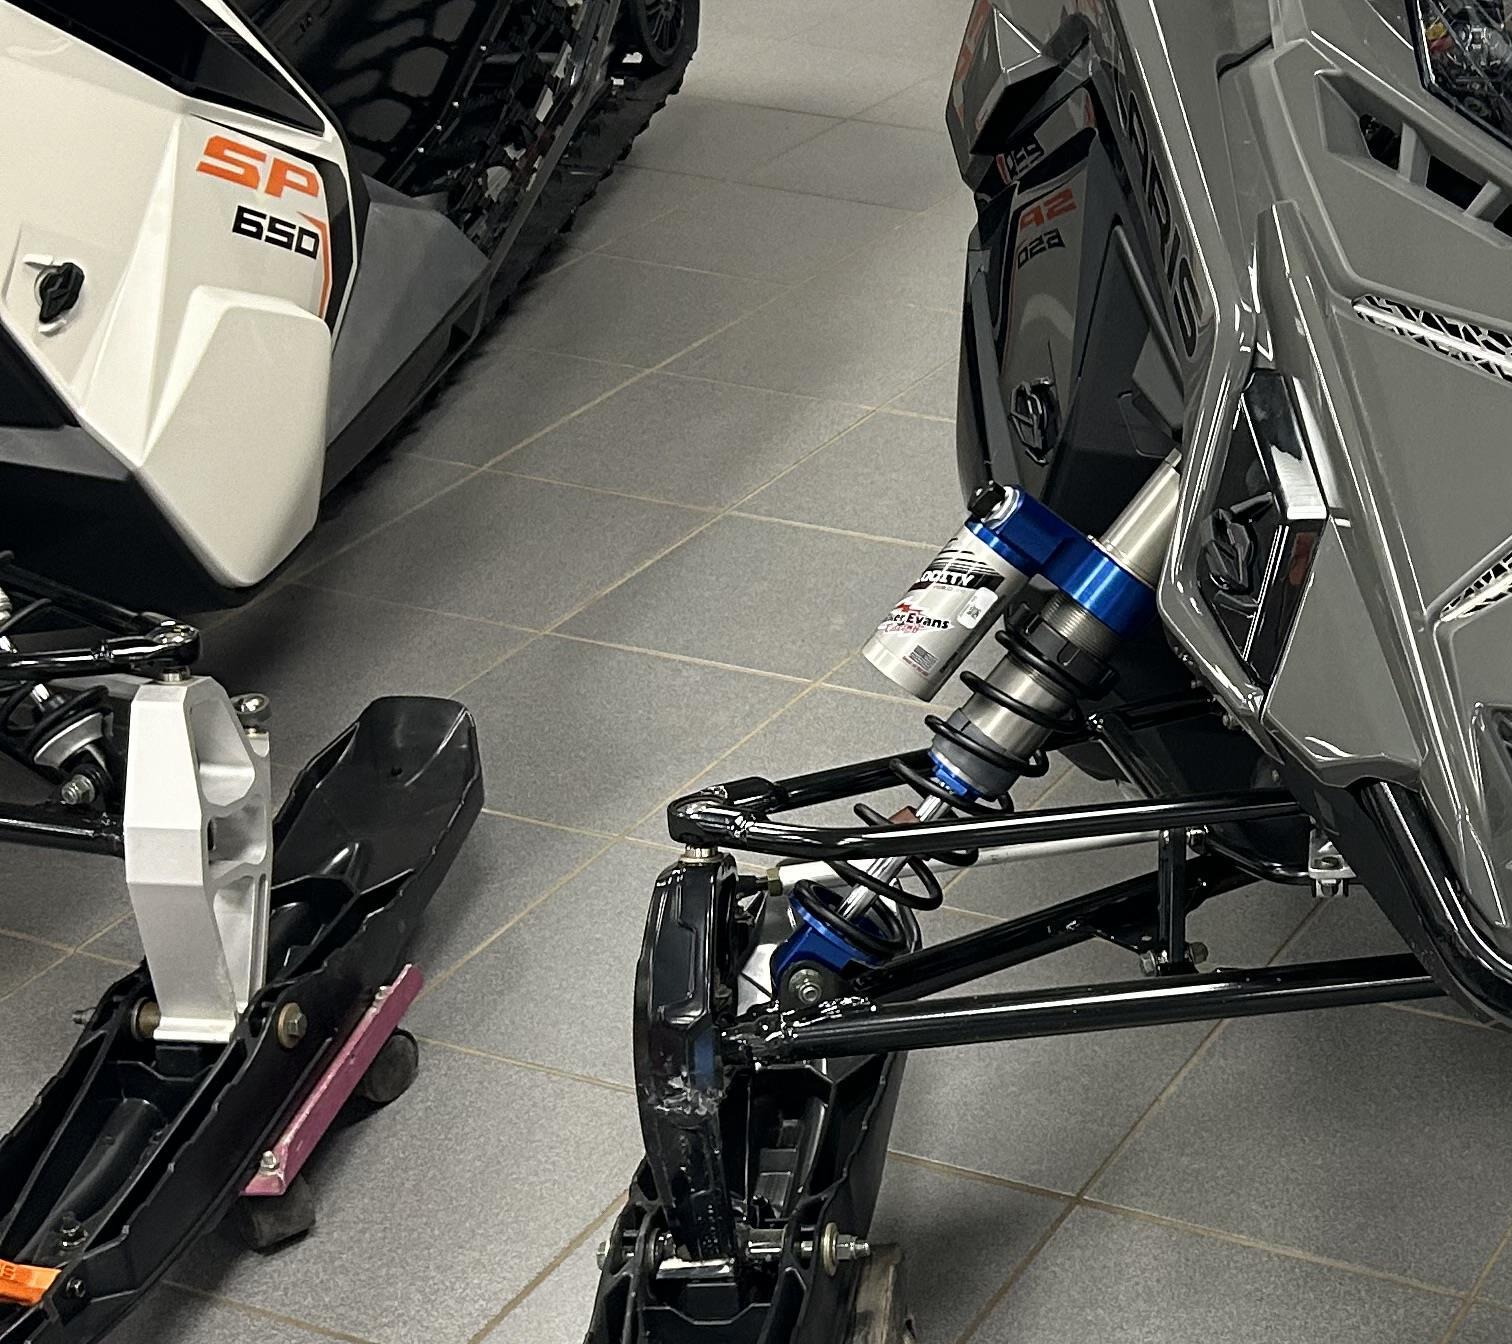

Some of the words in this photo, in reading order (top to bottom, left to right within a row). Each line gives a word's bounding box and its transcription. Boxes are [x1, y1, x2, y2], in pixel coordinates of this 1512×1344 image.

[195, 134, 320, 199] SP
[231, 204, 320, 260] 650
[906, 612, 950, 630] Evans
